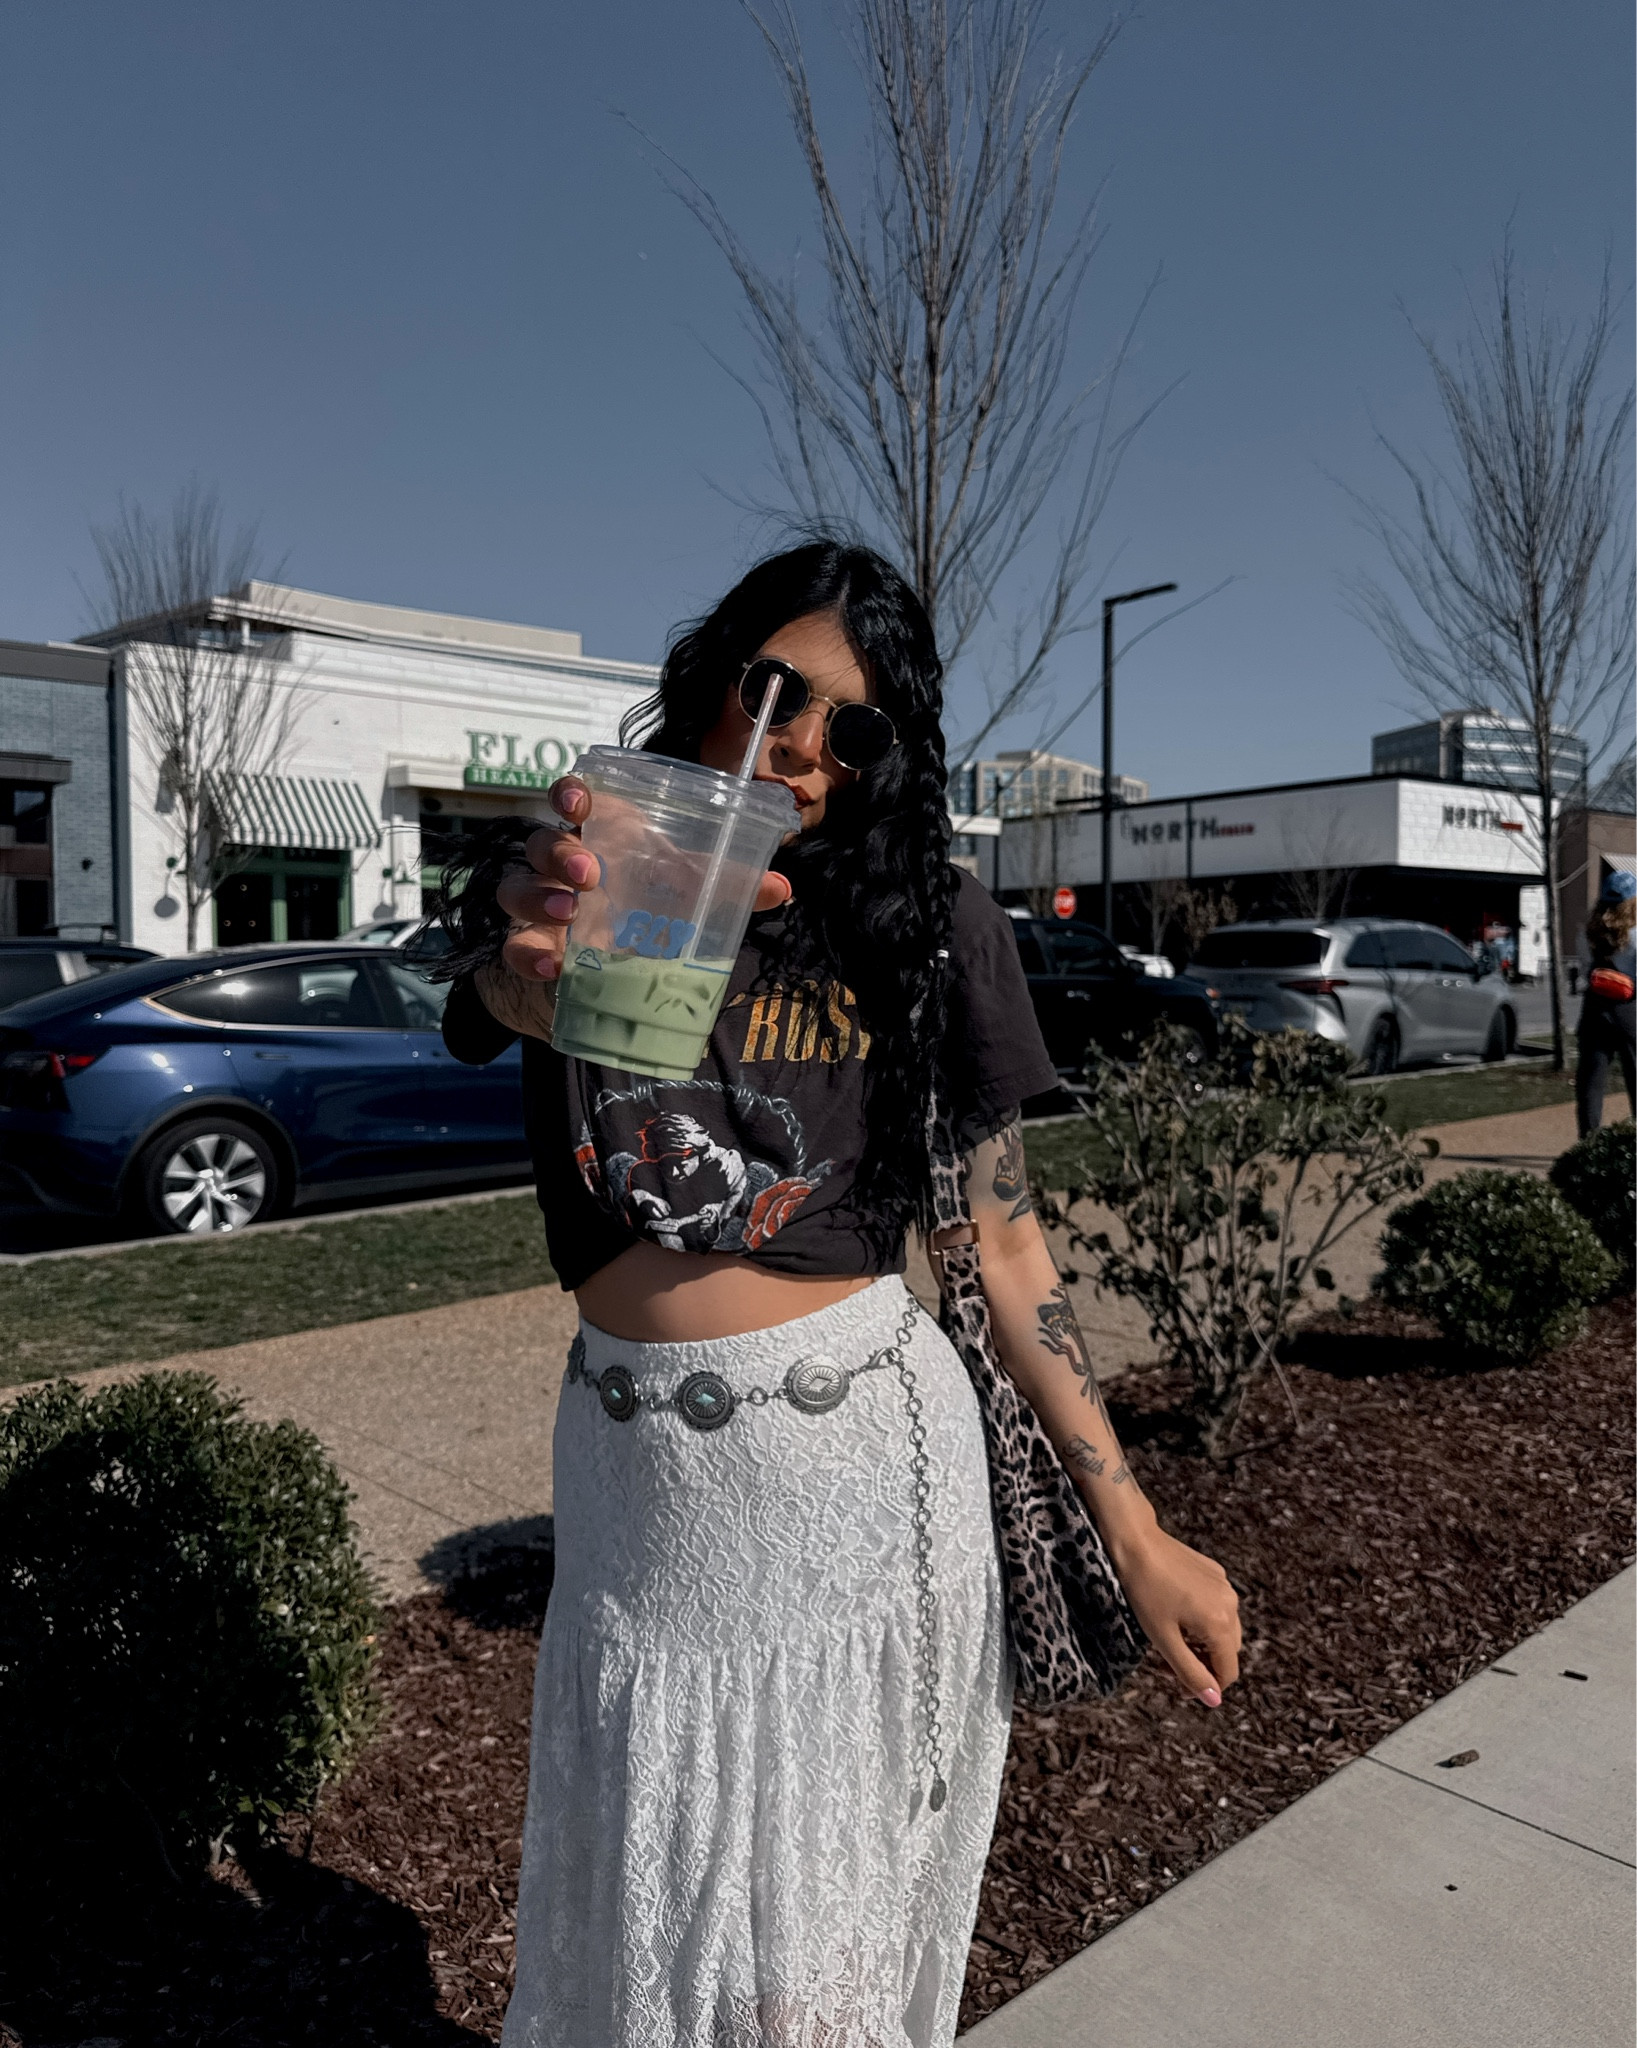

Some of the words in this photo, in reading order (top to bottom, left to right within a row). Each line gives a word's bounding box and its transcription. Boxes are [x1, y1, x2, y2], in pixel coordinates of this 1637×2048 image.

[1131, 816, 1218, 846] NORTH
[1443, 805, 1501, 831] NORTH
[615, 910, 698, 960] FLY
